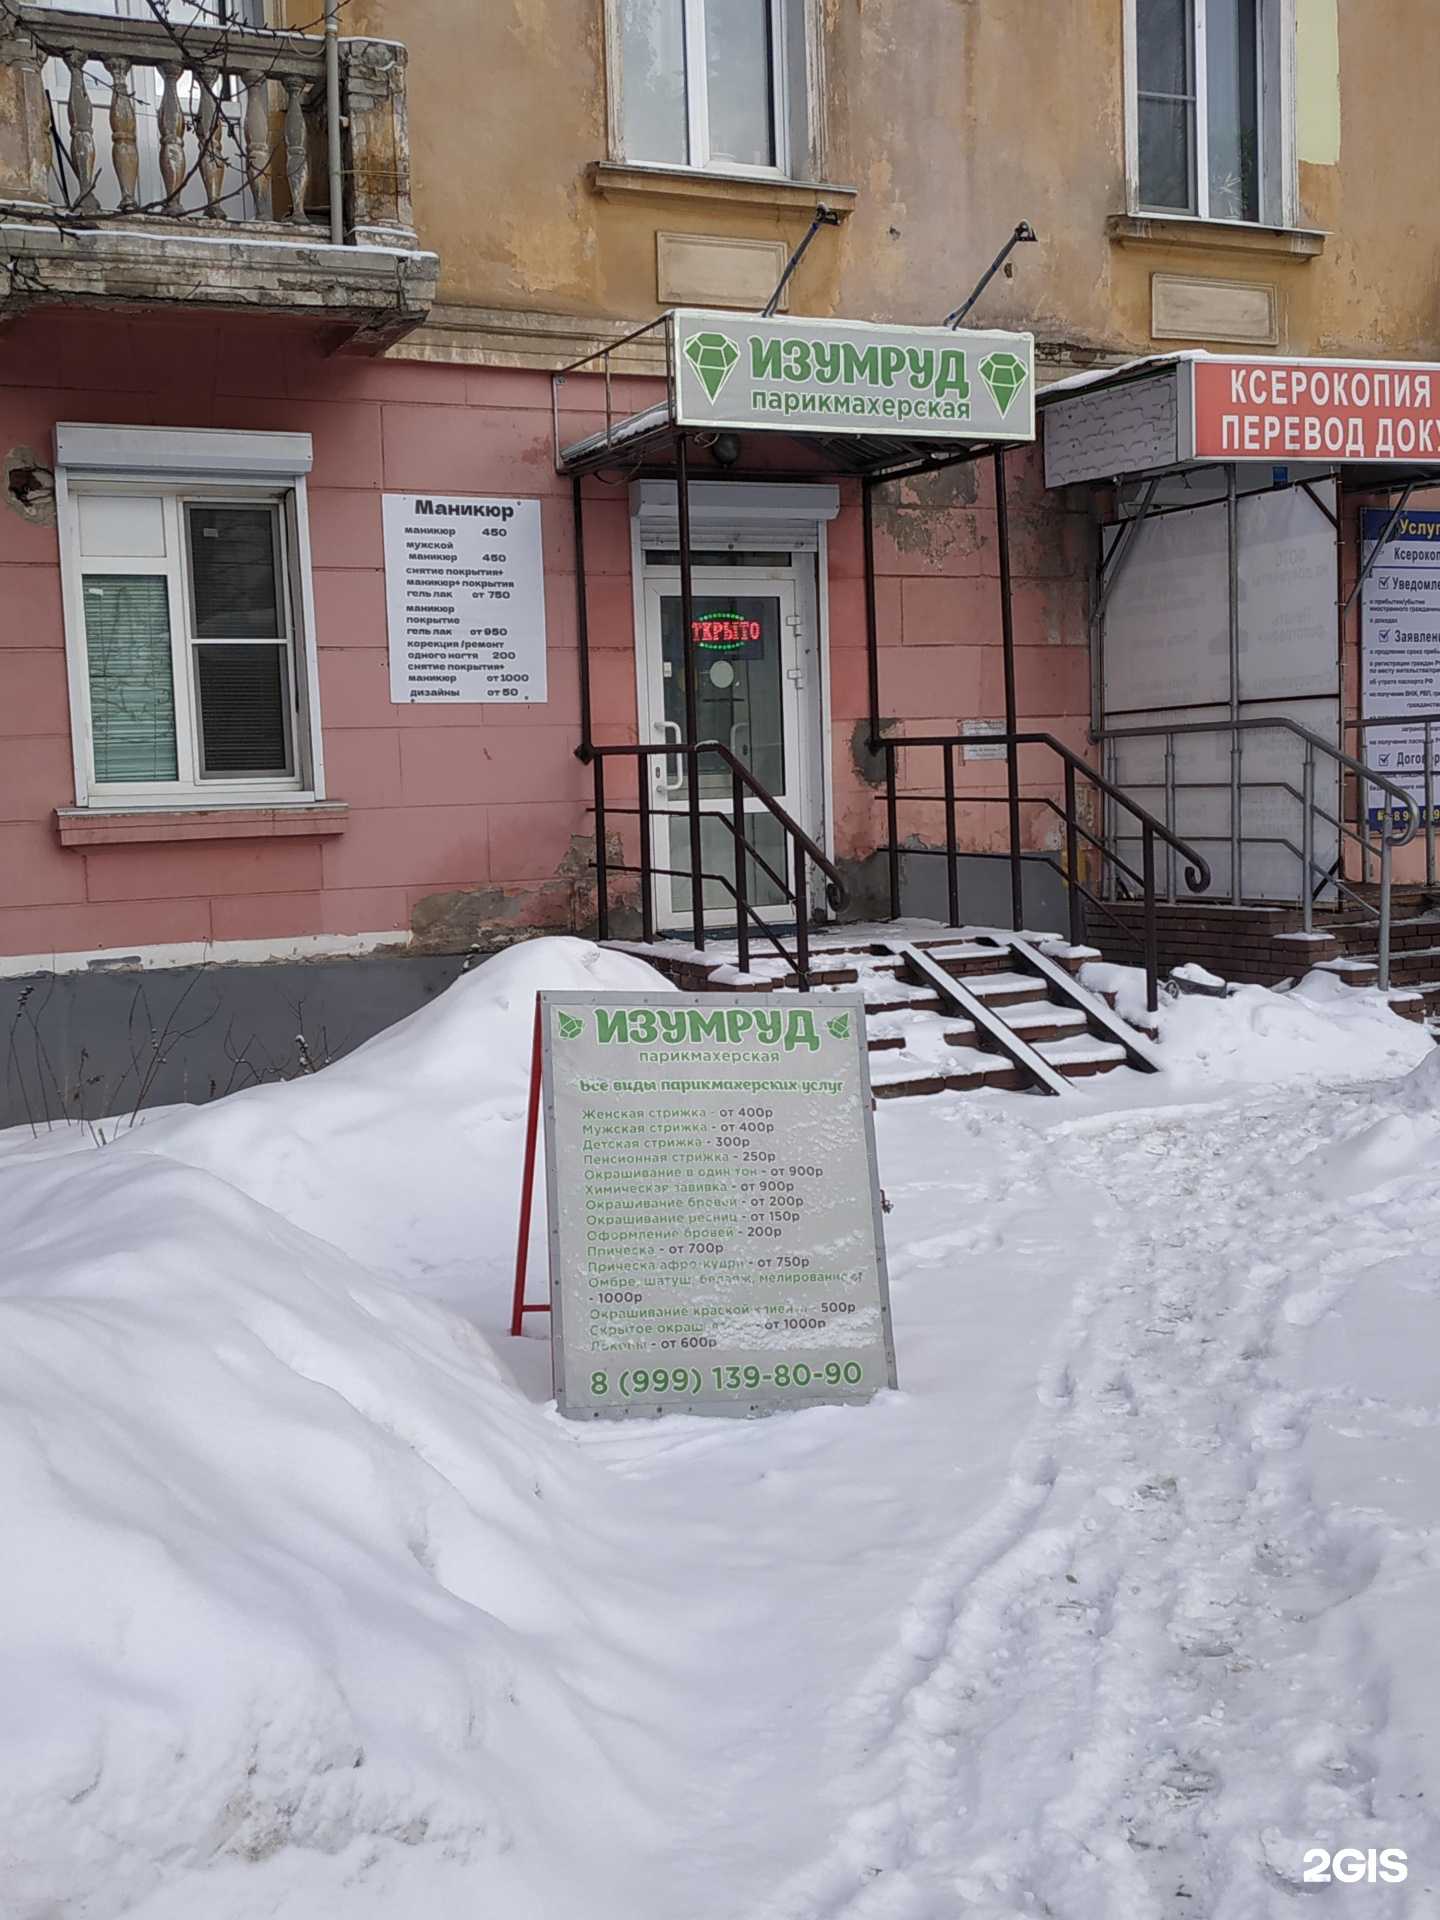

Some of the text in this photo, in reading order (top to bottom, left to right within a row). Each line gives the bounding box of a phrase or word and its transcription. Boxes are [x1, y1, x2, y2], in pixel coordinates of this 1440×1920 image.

[748, 335, 970, 399] ИЗУМРУД
[1231, 368, 1431, 408] КСЕРОКОПИЯ
[752, 390, 971, 421] парикмахерская
[1221, 414, 1365, 457] ПЕРЕВОД
[415, 499, 515, 522] Маникюр
[404, 527, 508, 537] маникюр 450
[406, 541, 454, 551] мужской
[408, 553, 506, 563] маникюр 450
[406, 567, 444, 575] снятие
[462, 580, 515, 589] покрытия
[407, 590, 431, 598] гель
[489, 590, 510, 599] 750
[406, 605, 455, 614] маникюр
[406, 616, 460, 625] покрытие
[407, 628, 431, 636] гель
[484, 628, 508, 636] 950
[692, 621, 760, 641] ТКРЫТО
[407, 640, 459, 650] корекция
[408, 651, 516, 660] одного ногтя 200
[408, 663, 446, 671] снятие
[408, 675, 457, 684] маникюр
[500, 674, 529, 682] 1000
[410, 688, 460, 698] дизайны
[502, 688, 518, 696] 50
[595, 1008, 821, 1051] ИЗУМРУД
[639, 1049, 780, 1064] парикмахерская
[613, 1081, 656, 1092] виды
[661, 1080, 797, 1093] парикмахерских
[802, 1081, 843, 1094] услуг
[582, 1110, 644, 1119] Женская
[649, 1109, 706, 1120] стрижка
[719, 1109, 734, 1117] от
[738, 1107, 773, 1118] 400р
[582, 1125, 645, 1136] Мужская
[650, 1123, 706, 1133] стрижка
[721, 1124, 735, 1132] от
[739, 1121, 774, 1132] 400р
[583, 1139, 639, 1151] Детская
[644, 1138, 702, 1149] стрижка
[715, 1136, 750, 1148] 300р
[584, 1154, 667, 1165] Пенсионная
[672, 1153, 729, 1163] стрижка
[742, 1151, 776, 1162] 250р
[584, 1169, 681, 1181] Окрашивание
[687, 1169, 693, 1177] в
[698, 1168, 730, 1178] один
[735, 1168, 757, 1176] тон
[770, 1168, 784, 1176] от
[789, 1166, 823, 1177] 900р
[740, 1183, 755, 1191] от
[759, 1181, 794, 1193] 900р
[585, 1199, 683, 1211] Окрашивание
[750, 1198, 765, 1206] от
[769, 1196, 804, 1207] 200р
[586, 1214, 684, 1226] Окрашивание
[750, 1213, 765, 1221] от
[770, 1211, 800, 1222] 150р
[747, 1226, 782, 1238] 200р
[587, 1245, 655, 1257] Прическа
[668, 1245, 684, 1254] от
[688, 1242, 724, 1255] 700р
[588, 1261, 655, 1273] Прическа
[757, 1259, 772, 1267] от
[776, 1256, 810, 1268] 750р
[599, 1291, 642, 1304] 1000р
[590, 1307, 688, 1320] Окрашивание
[821, 1302, 856, 1314] 500р
[764, 1321, 780, 1330] от
[661, 1339, 676, 1349] от
[680, 1336, 717, 1349] 600р
[590, 1361, 863, 1397] 8 (999) 139-80-90
